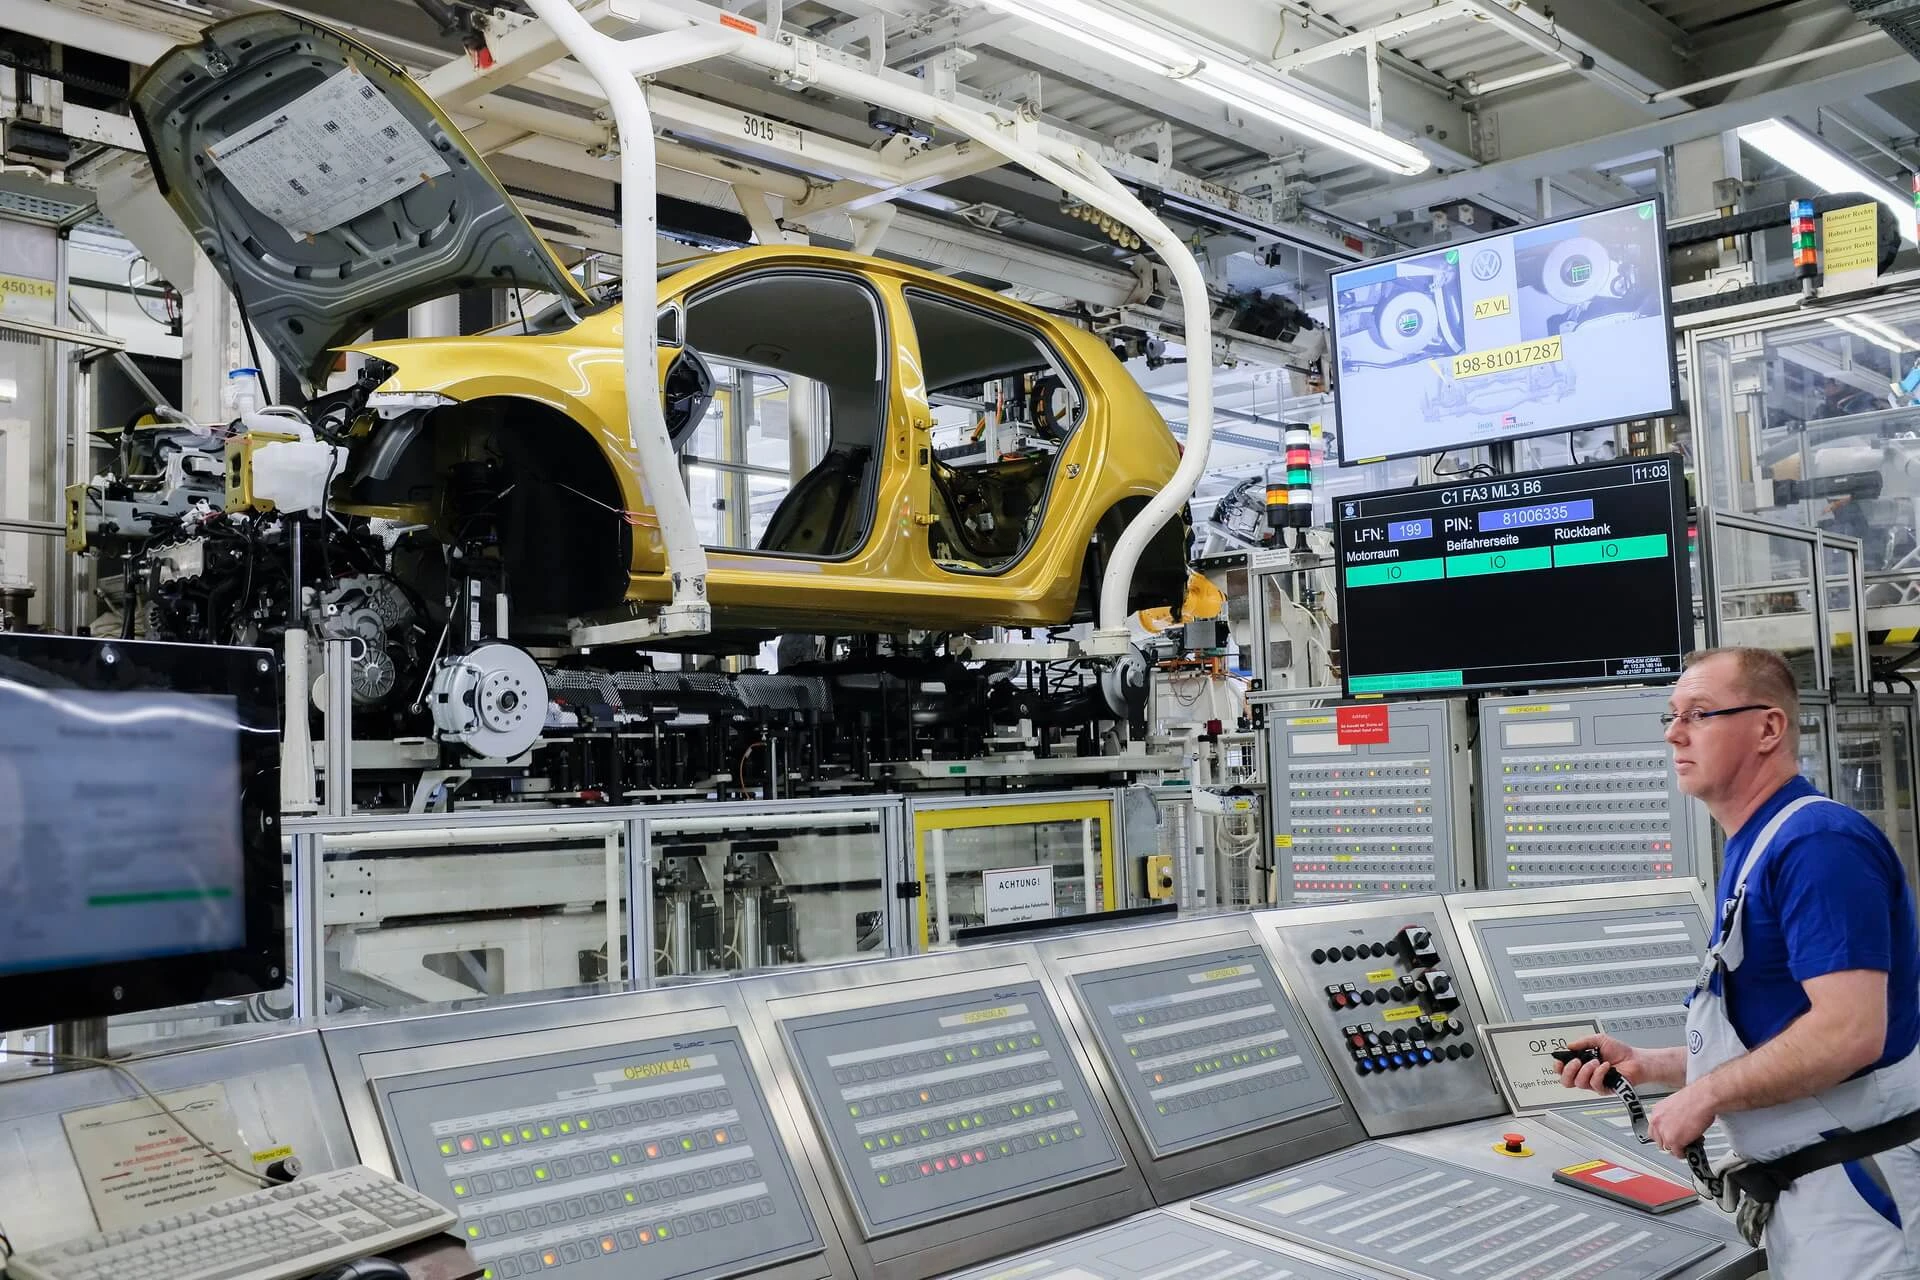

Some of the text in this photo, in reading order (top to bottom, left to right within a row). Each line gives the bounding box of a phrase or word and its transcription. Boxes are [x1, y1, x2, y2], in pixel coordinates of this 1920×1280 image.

[744, 115, 774, 141] 3015
[1474, 299, 1509, 317] A7 VL
[1455, 342, 1560, 375] 198-81017287
[1634, 464, 1668, 480] 11:03
[1441, 480, 1542, 505] C1 FA3 ML3 B6
[1444, 505, 1568, 533] PIN: 81006335
[1354, 523, 1422, 543] LFN: 199
[1554, 523, 1612, 540] Rückbank
[1446, 534, 1520, 552] Beifahrerseite
[1346, 548, 1399, 563] Motorraum
[999, 878, 1040, 890] ACHTUNG!
[1529, 1038, 1567, 1053] OP 50
[1513, 1080, 1536, 1090] Fügen
